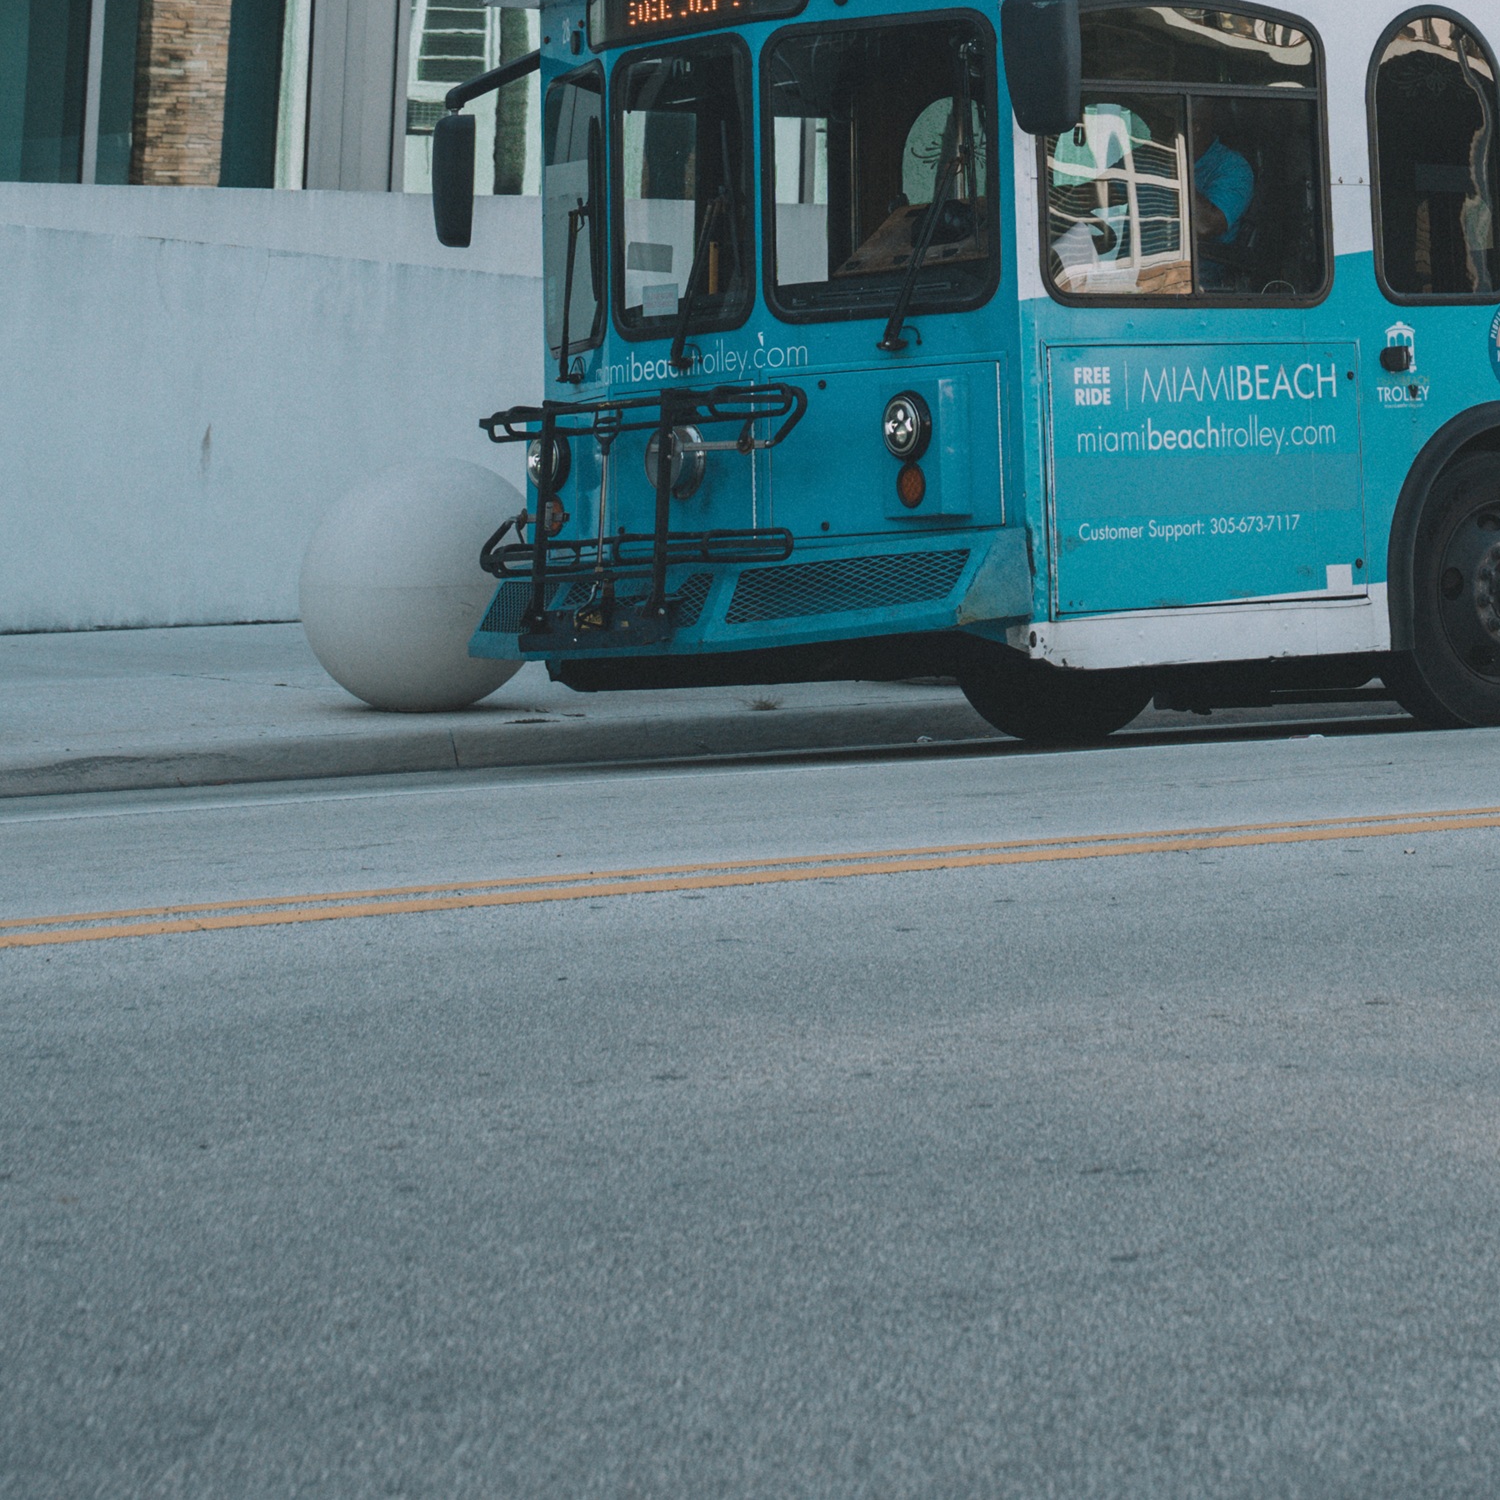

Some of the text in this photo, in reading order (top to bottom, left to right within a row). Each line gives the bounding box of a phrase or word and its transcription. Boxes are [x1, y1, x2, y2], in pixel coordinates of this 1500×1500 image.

[1074, 367, 1111, 384] FREE
[1141, 363, 1337, 403] MIAMIBEACH
[1074, 388, 1111, 405] RIDE
[1077, 414, 1336, 455] miamibeachtrolley.com
[1079, 514, 1300, 542] Customer Support: 305-673-7117
